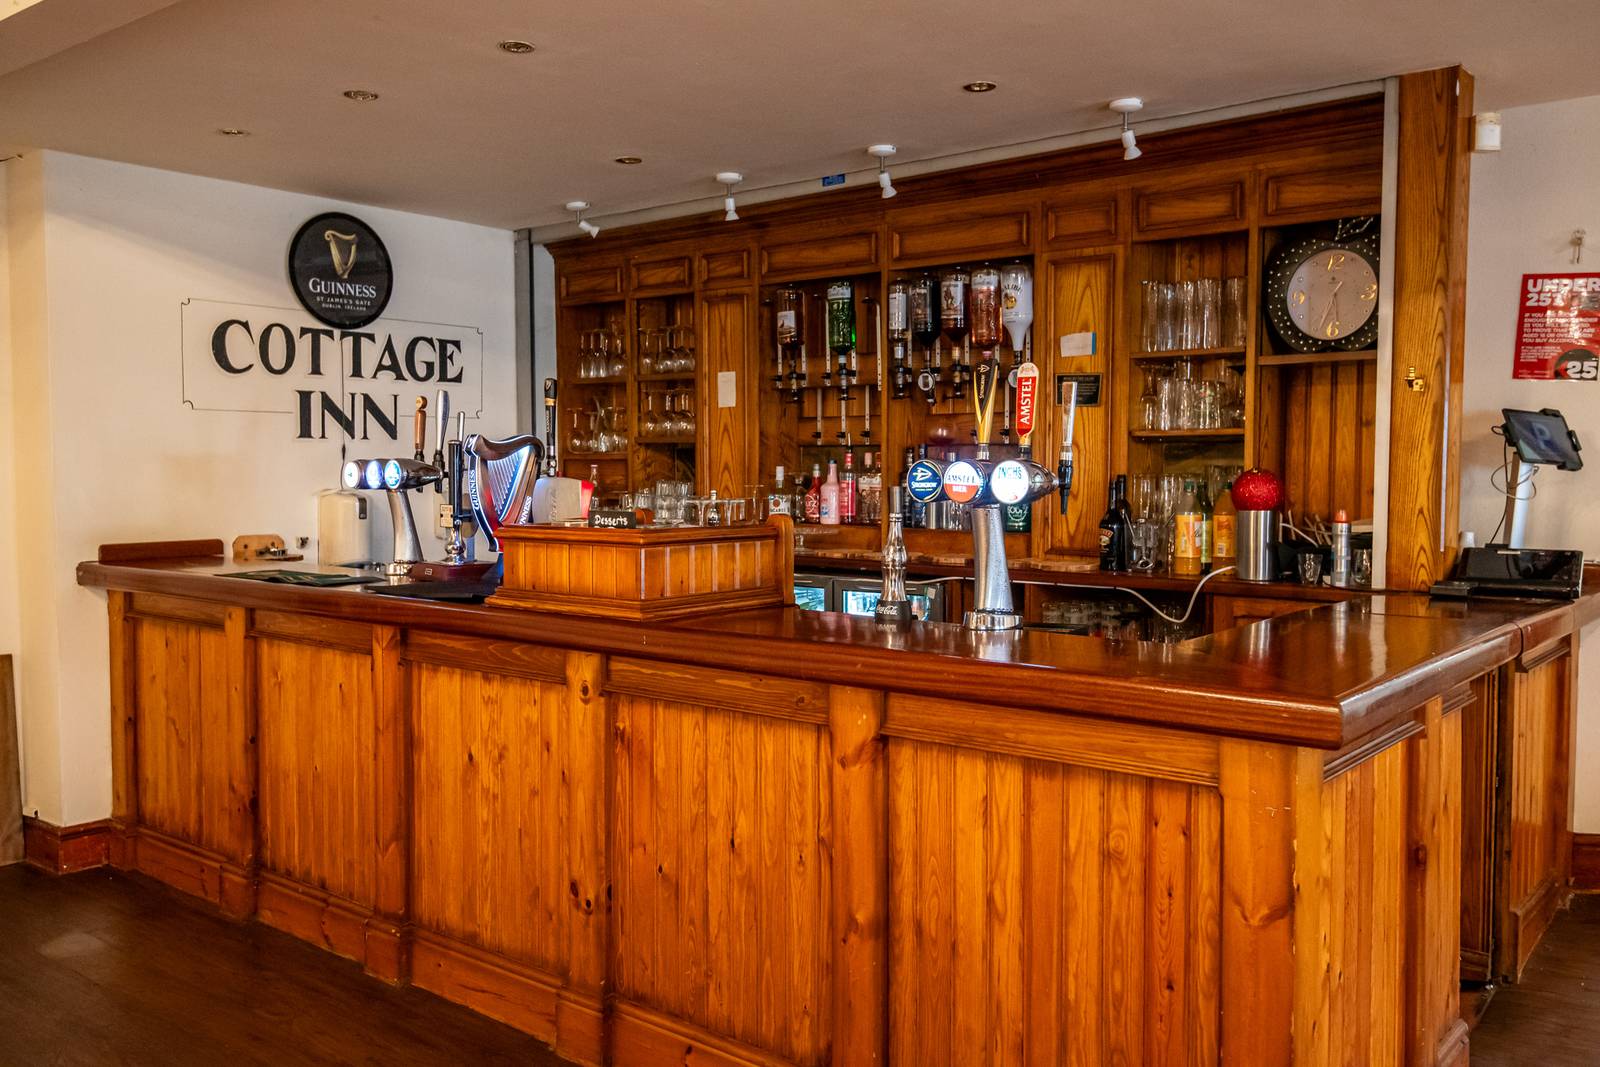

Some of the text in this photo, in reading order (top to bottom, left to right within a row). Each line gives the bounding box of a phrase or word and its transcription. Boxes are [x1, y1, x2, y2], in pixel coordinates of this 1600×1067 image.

[308, 277, 377, 298] GUINNESS
[211, 319, 464, 384] COTTAGE
[1566, 360, 1598, 379] 25
[295, 389, 400, 441] INN
[1020, 378, 1032, 425] AMSTEL
[470, 468, 480, 511] GUINNESS
[519, 495, 532, 525] NNESS
[594, 514, 628, 526] Desserts
